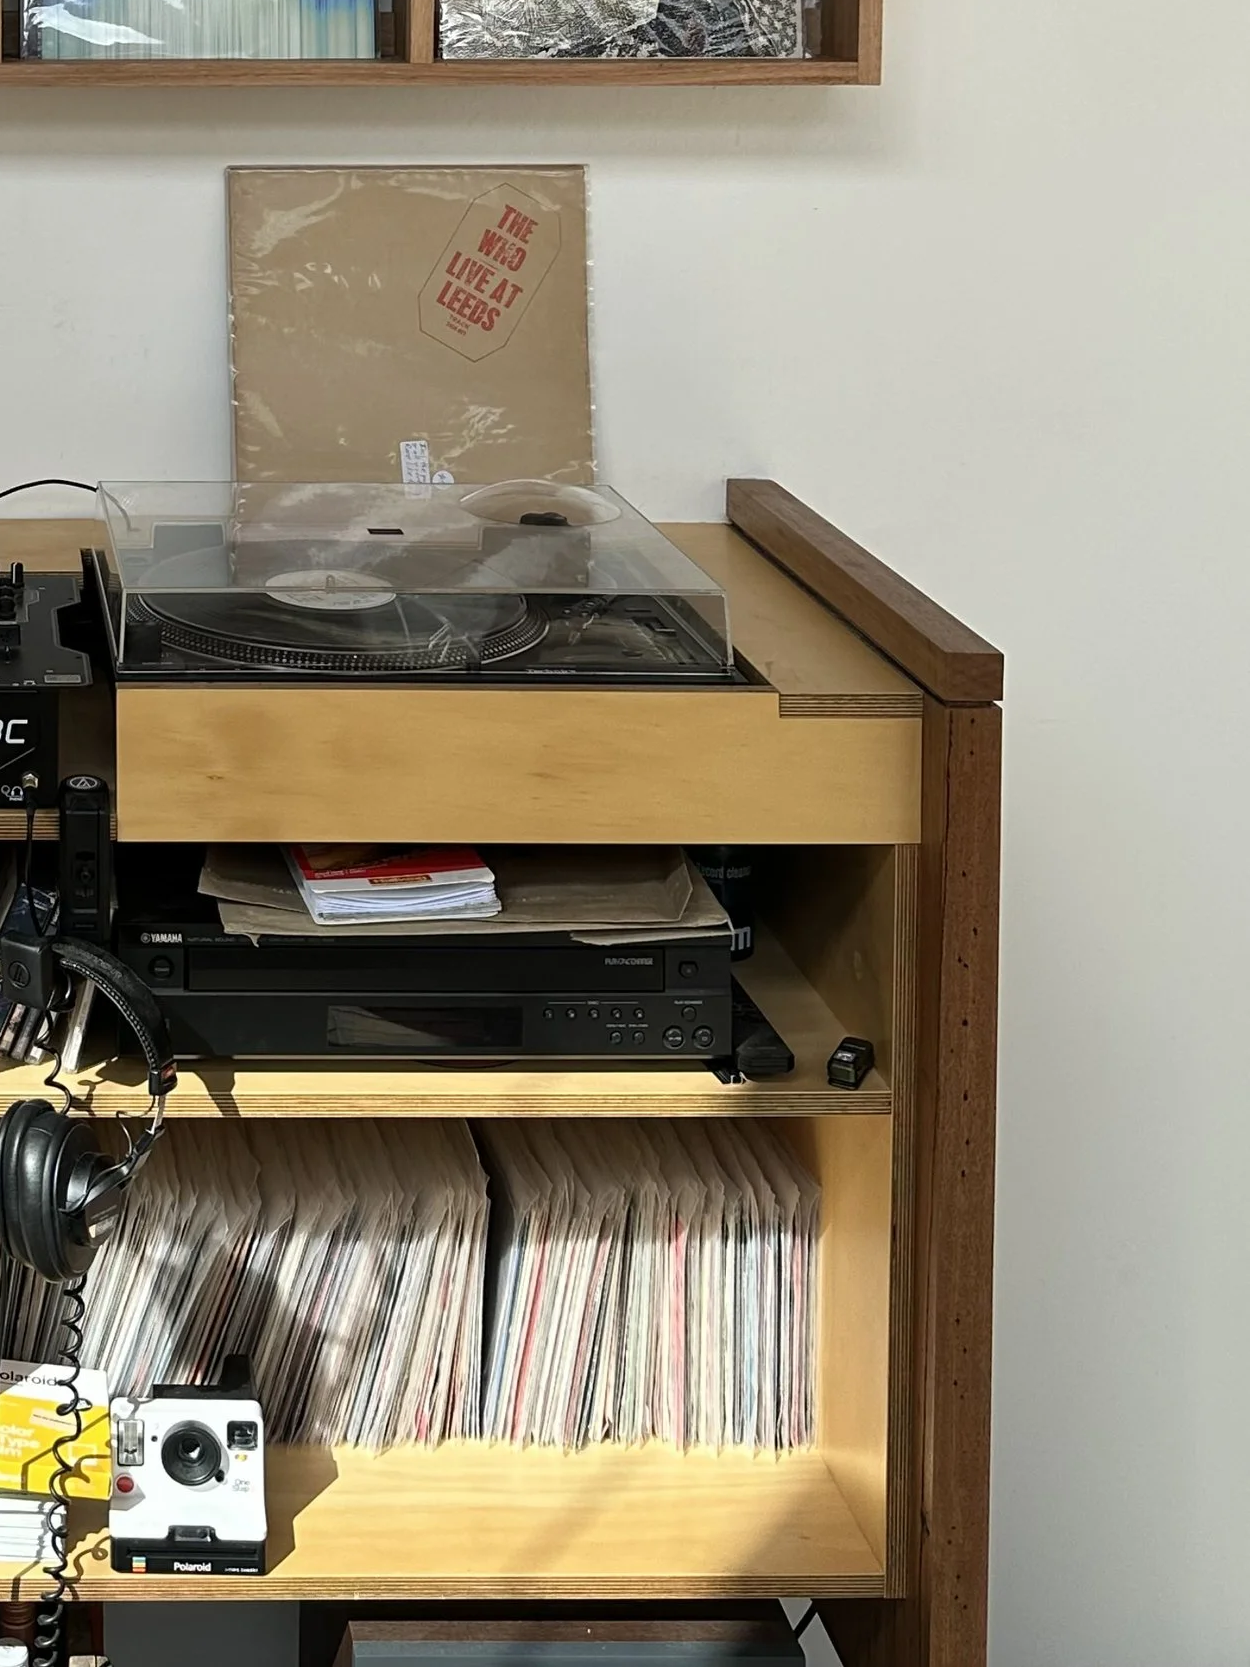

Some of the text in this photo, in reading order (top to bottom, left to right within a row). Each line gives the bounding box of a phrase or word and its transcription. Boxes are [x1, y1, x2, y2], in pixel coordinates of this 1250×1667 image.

[497, 204, 539, 244] THE
[478, 229, 527, 272] WHO
[445, 251, 524, 309] LIVE AT
[436, 280, 501, 331] LEEDS
[150, 933, 183, 943] YAMAHA
[174, 1562, 211, 1572] Polaroid
